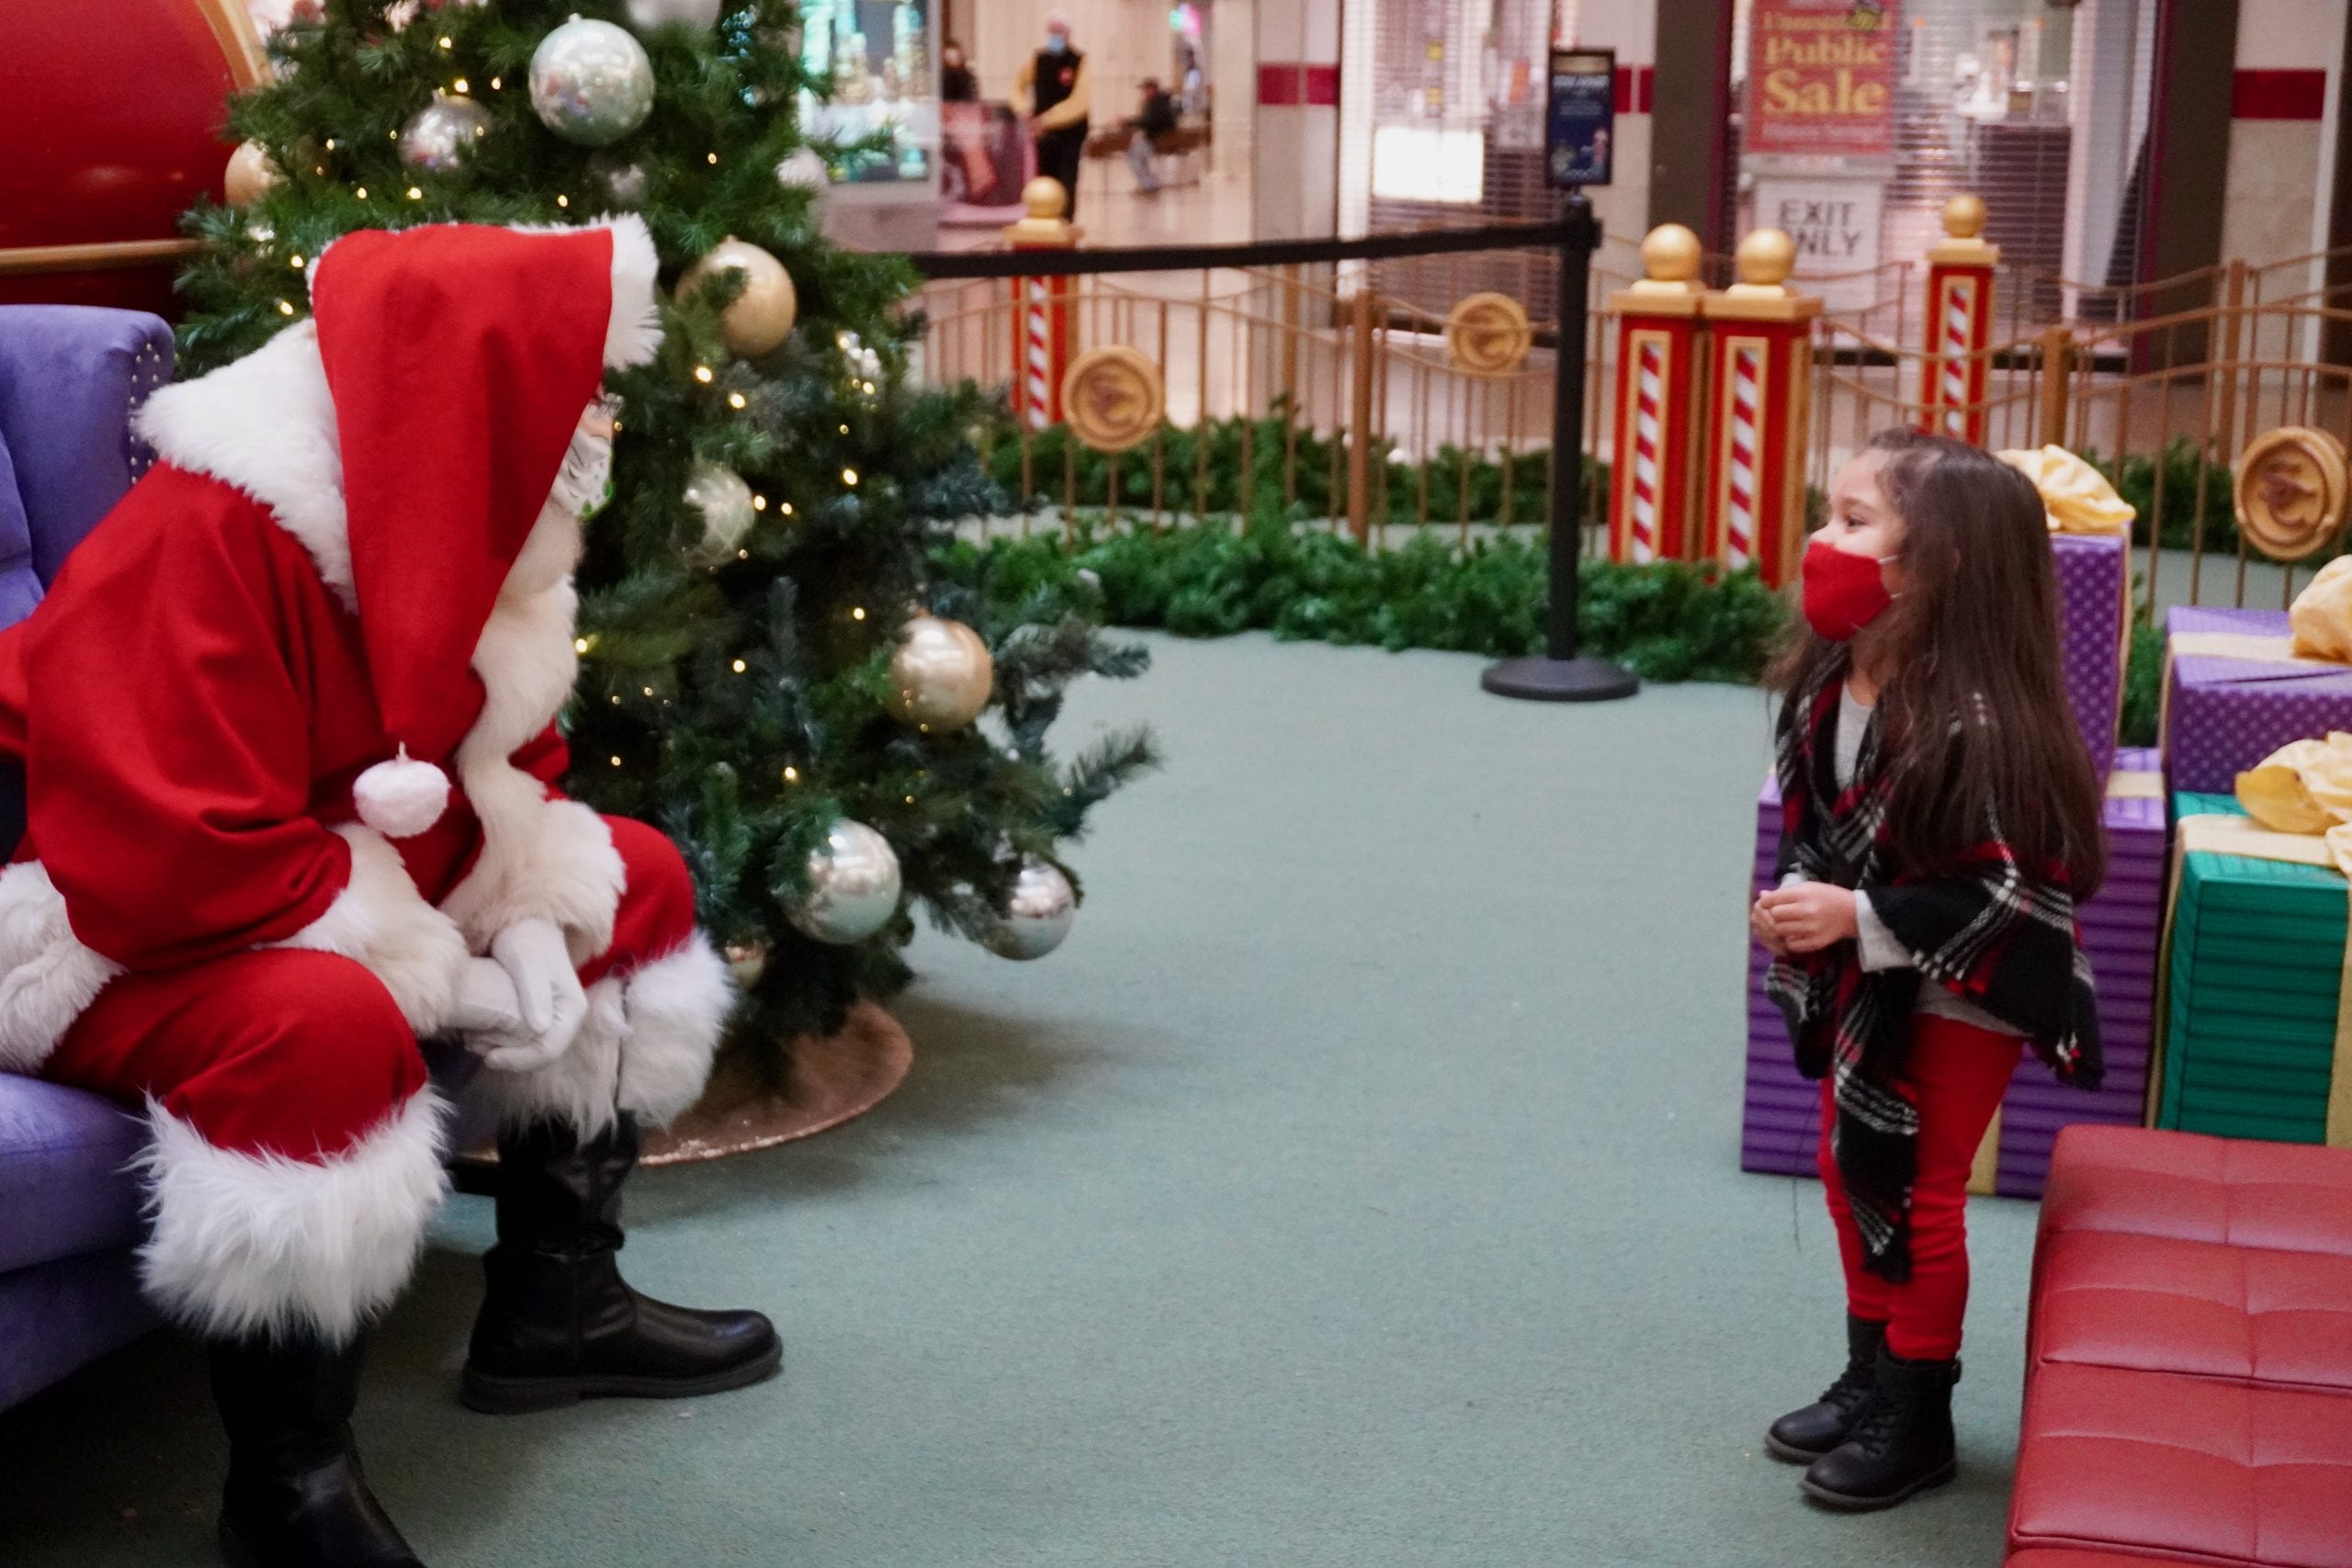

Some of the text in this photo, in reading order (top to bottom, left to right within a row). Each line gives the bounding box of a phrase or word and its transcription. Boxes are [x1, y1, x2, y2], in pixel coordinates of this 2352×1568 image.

[1766, 35, 1886, 65] Public
[1762, 69, 1886, 116] Sale
[1780, 200, 1856, 226] EXIT
[1794, 231, 1860, 256] NLY
